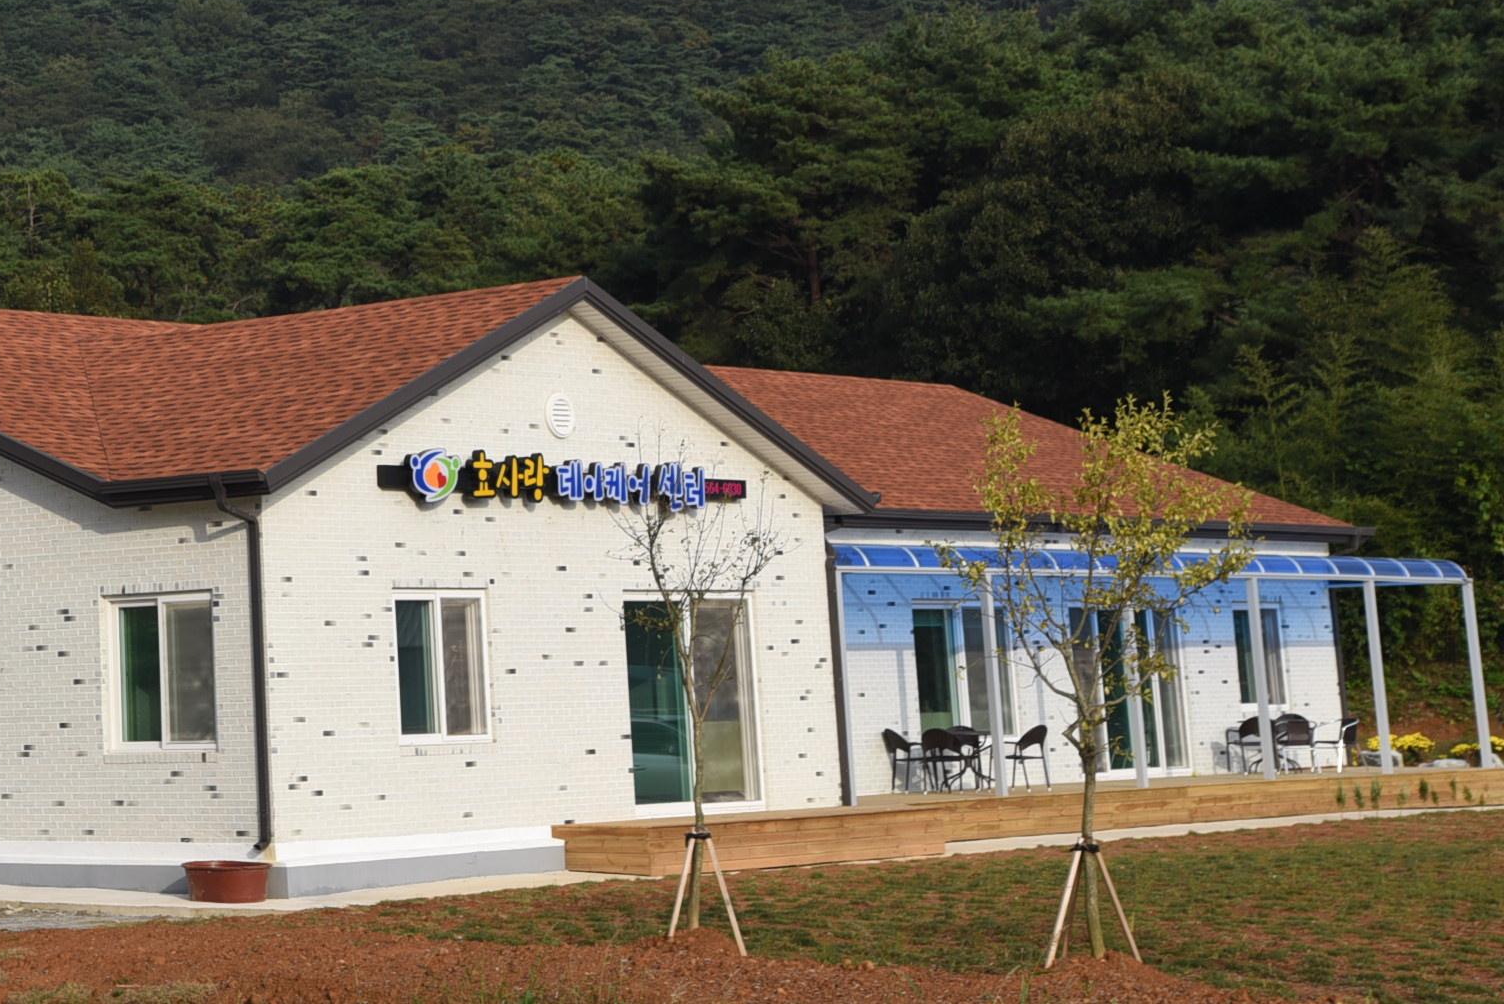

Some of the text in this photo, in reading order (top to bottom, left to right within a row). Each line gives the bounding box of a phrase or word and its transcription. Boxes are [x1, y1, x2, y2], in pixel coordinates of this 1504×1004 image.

[472, 452, 705, 512] 효사랑 데이케어 센터
